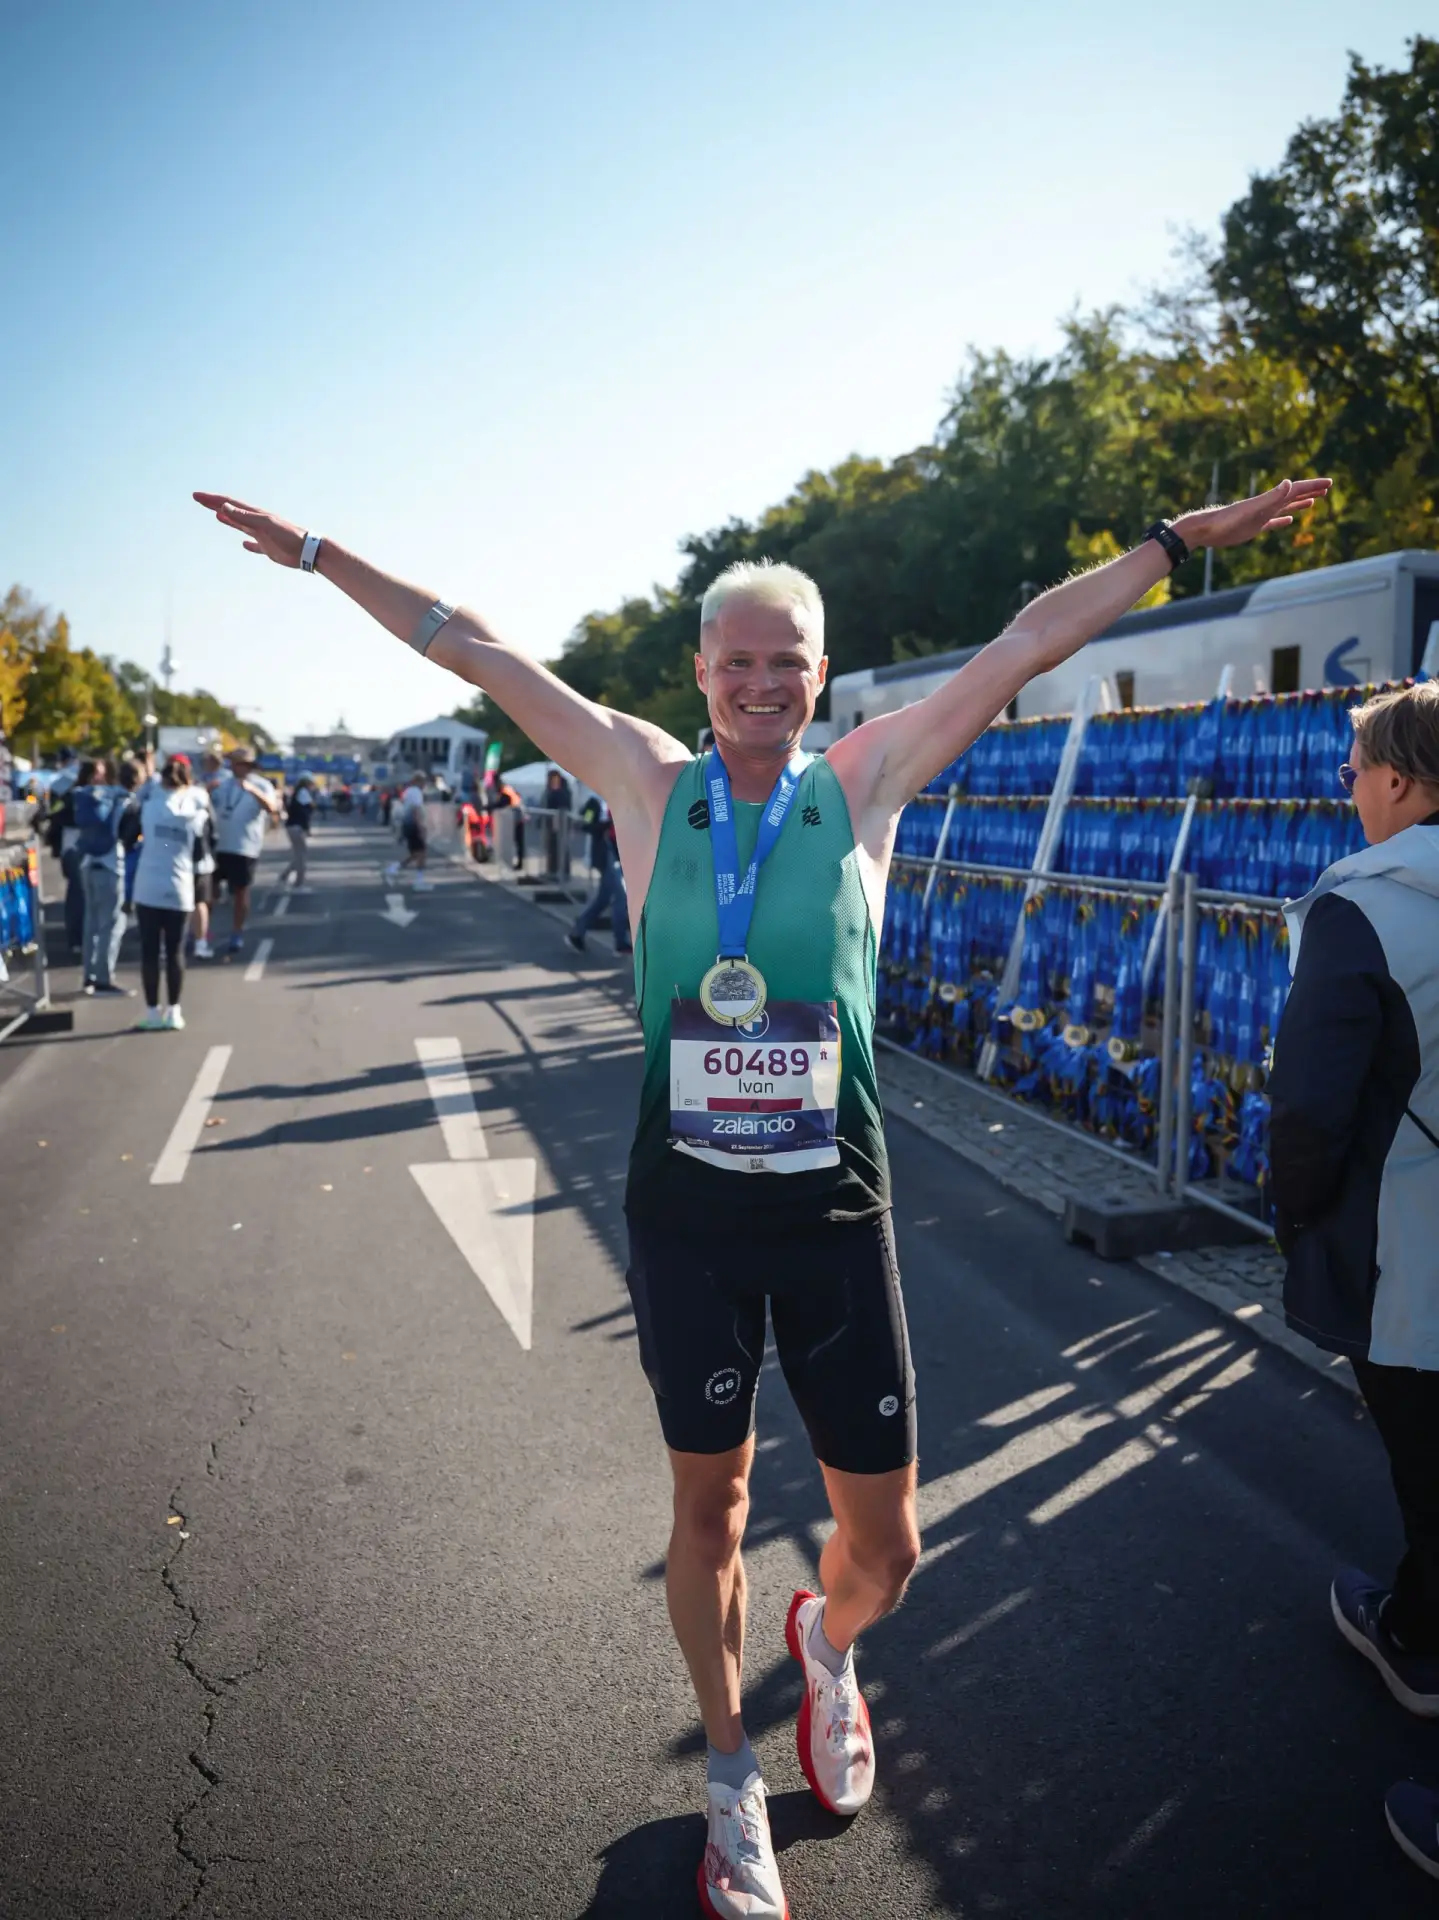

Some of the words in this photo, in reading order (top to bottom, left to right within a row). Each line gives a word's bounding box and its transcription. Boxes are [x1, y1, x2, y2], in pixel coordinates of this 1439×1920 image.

[776, 783, 796, 803] BERLIN
[714, 799, 728, 822] LEGEND
[768, 802, 788, 826] LEGEND
[716, 873, 724, 906] MARATHON
[721, 873, 729, 894] BERLIN
[727, 873, 735, 894] BMW
[703, 1047, 809, 1076] 60489
[738, 1078, 774, 1094] Ivan
[712, 1115, 796, 1135] zalando
[714, 1379, 734, 1393] 66
